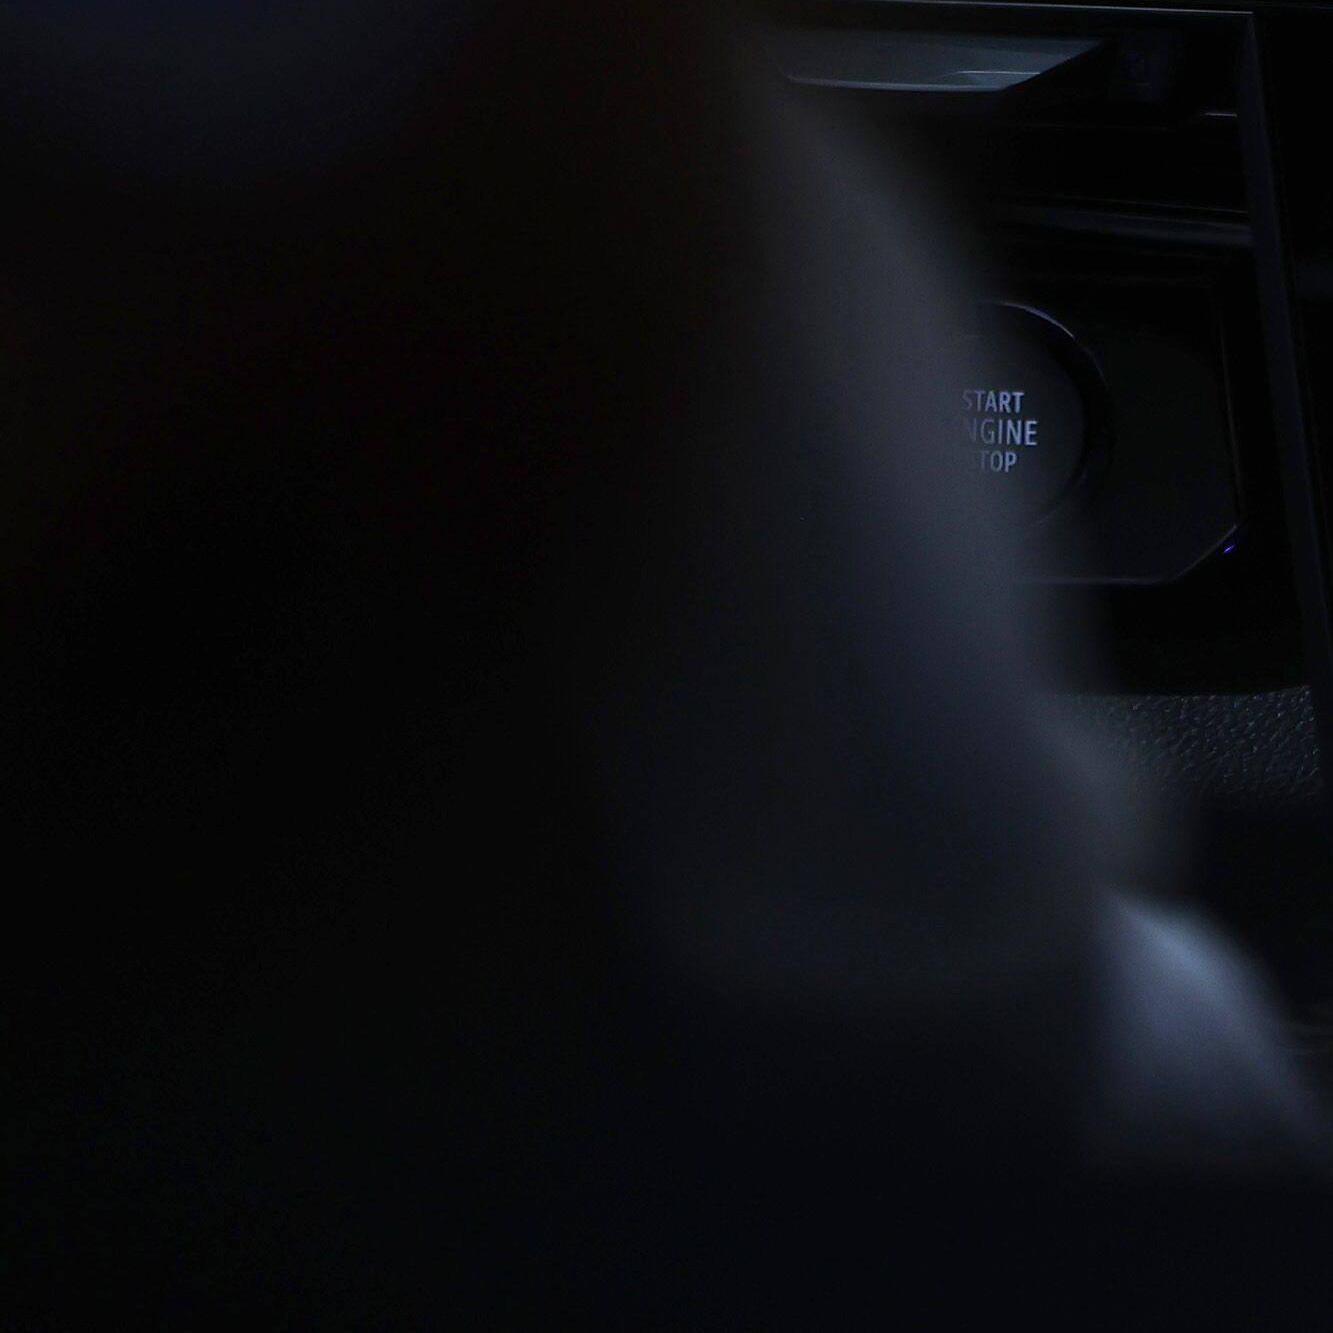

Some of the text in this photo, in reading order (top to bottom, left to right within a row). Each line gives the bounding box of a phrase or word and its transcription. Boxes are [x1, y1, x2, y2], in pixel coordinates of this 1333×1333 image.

[962, 389, 1025, 414] START
[968, 418, 1039, 447] NGINE
[977, 450, 1018, 474] TOP
